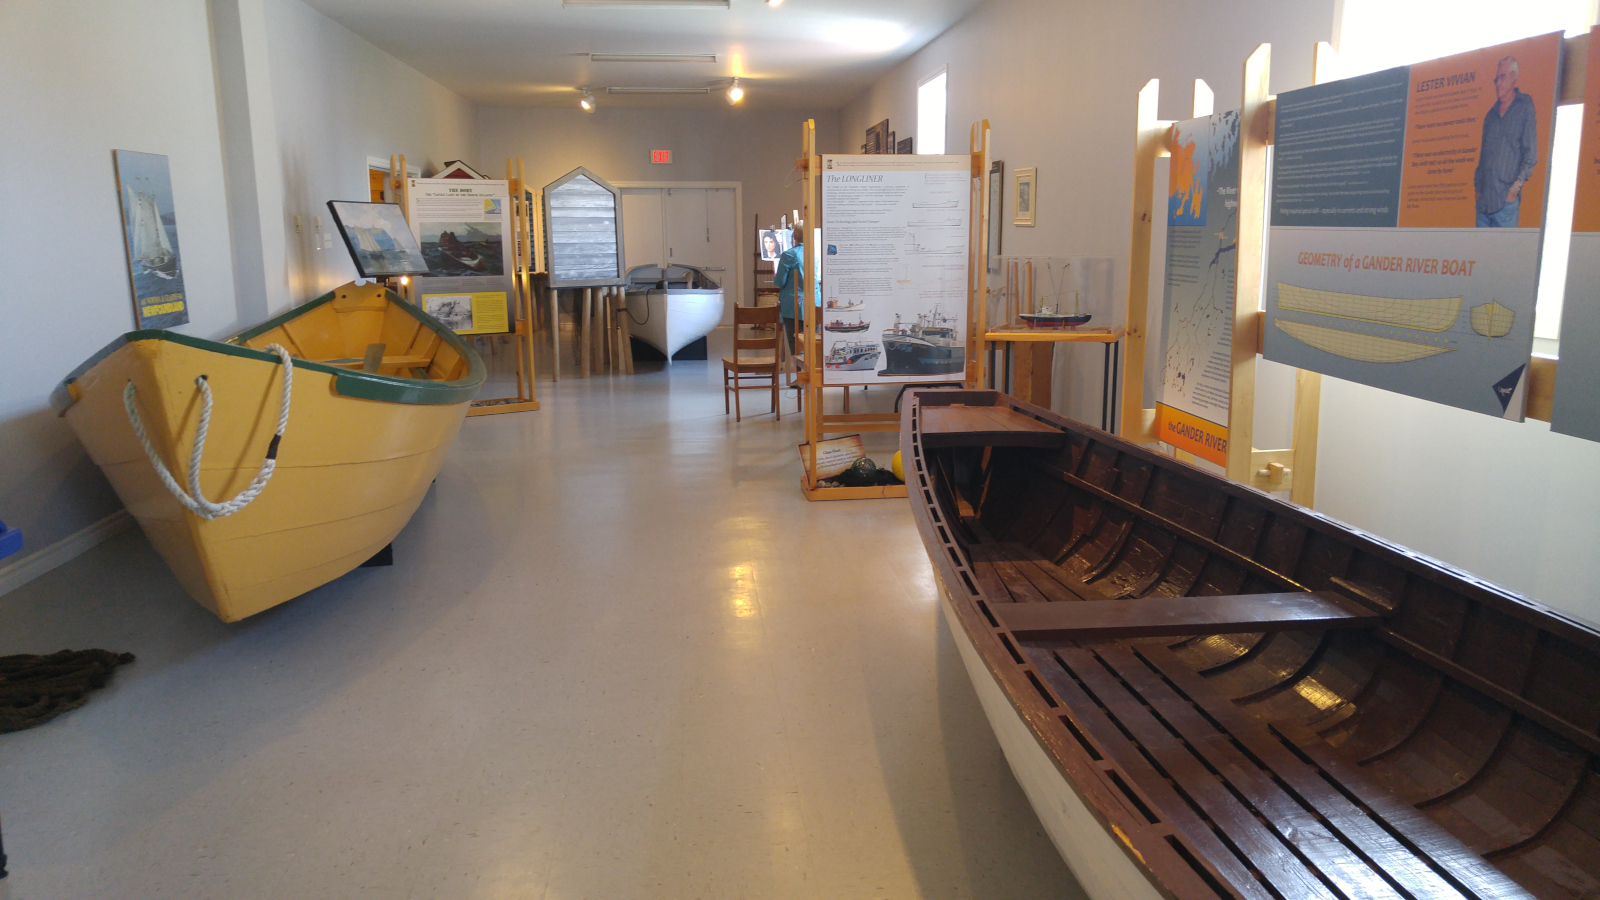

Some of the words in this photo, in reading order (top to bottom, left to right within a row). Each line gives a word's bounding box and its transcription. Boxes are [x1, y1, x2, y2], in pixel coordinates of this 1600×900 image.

[1416, 77, 1445, 93] LESTER
[1447, 72, 1476, 86] VIVIAN
[653, 150, 670, 163] EXIT
[842, 174, 884, 182] LONGLINER
[1298, 252, 1343, 268] GEOMETRY
[1343, 254, 1354, 272] of
[1354, 259, 1360, 270] a
[1362, 255, 1404, 272] GANDER
[1405, 258, 1438, 274] RIVER
[1440, 260, 1476, 276] BOAT
[1168, 421, 1176, 432] the
[1176, 422, 1204, 445] GANDER
[1204, 433, 1228, 454] RIVER
